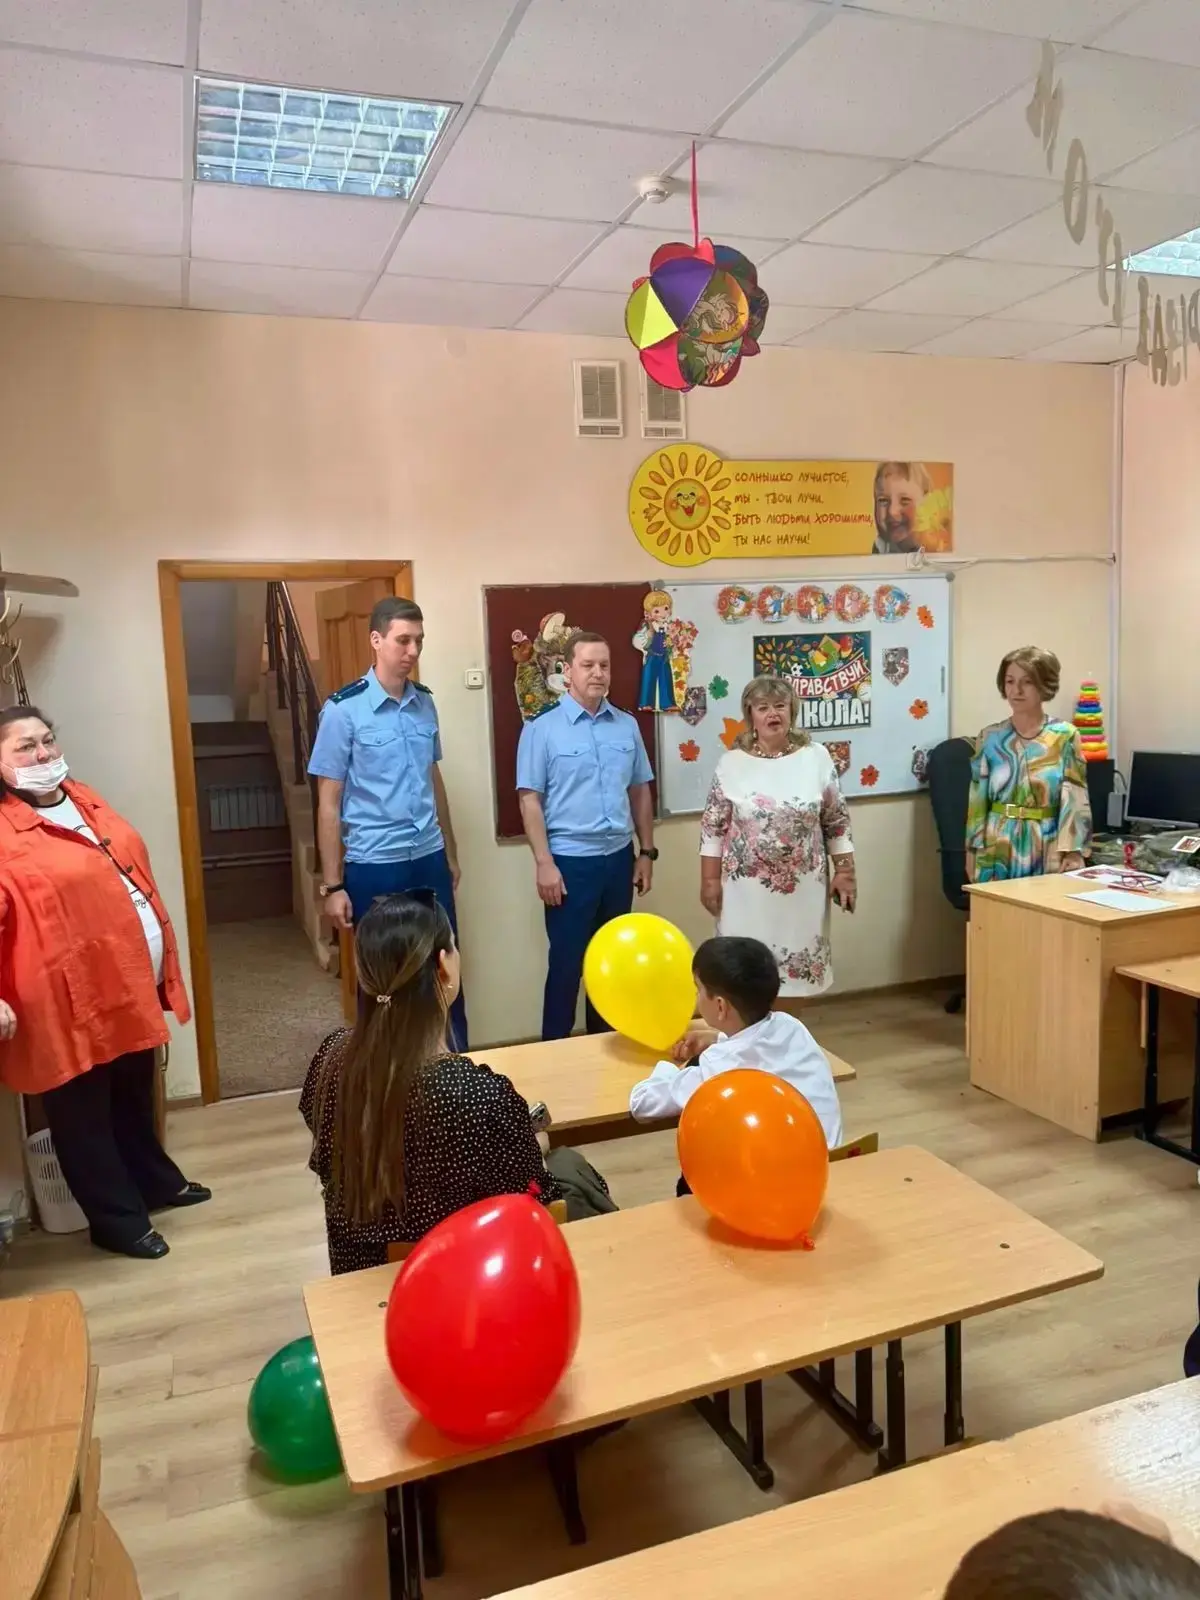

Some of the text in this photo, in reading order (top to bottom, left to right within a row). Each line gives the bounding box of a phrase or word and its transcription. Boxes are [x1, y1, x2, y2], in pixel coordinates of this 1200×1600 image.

[734, 472, 793, 483] СОЛНЫШКО
[765, 492, 792, 504] ТВОИ
[732, 513, 761, 526] БЫТЬ
[733, 532, 811, 546] ТЫ НАС НАУЧИ!
